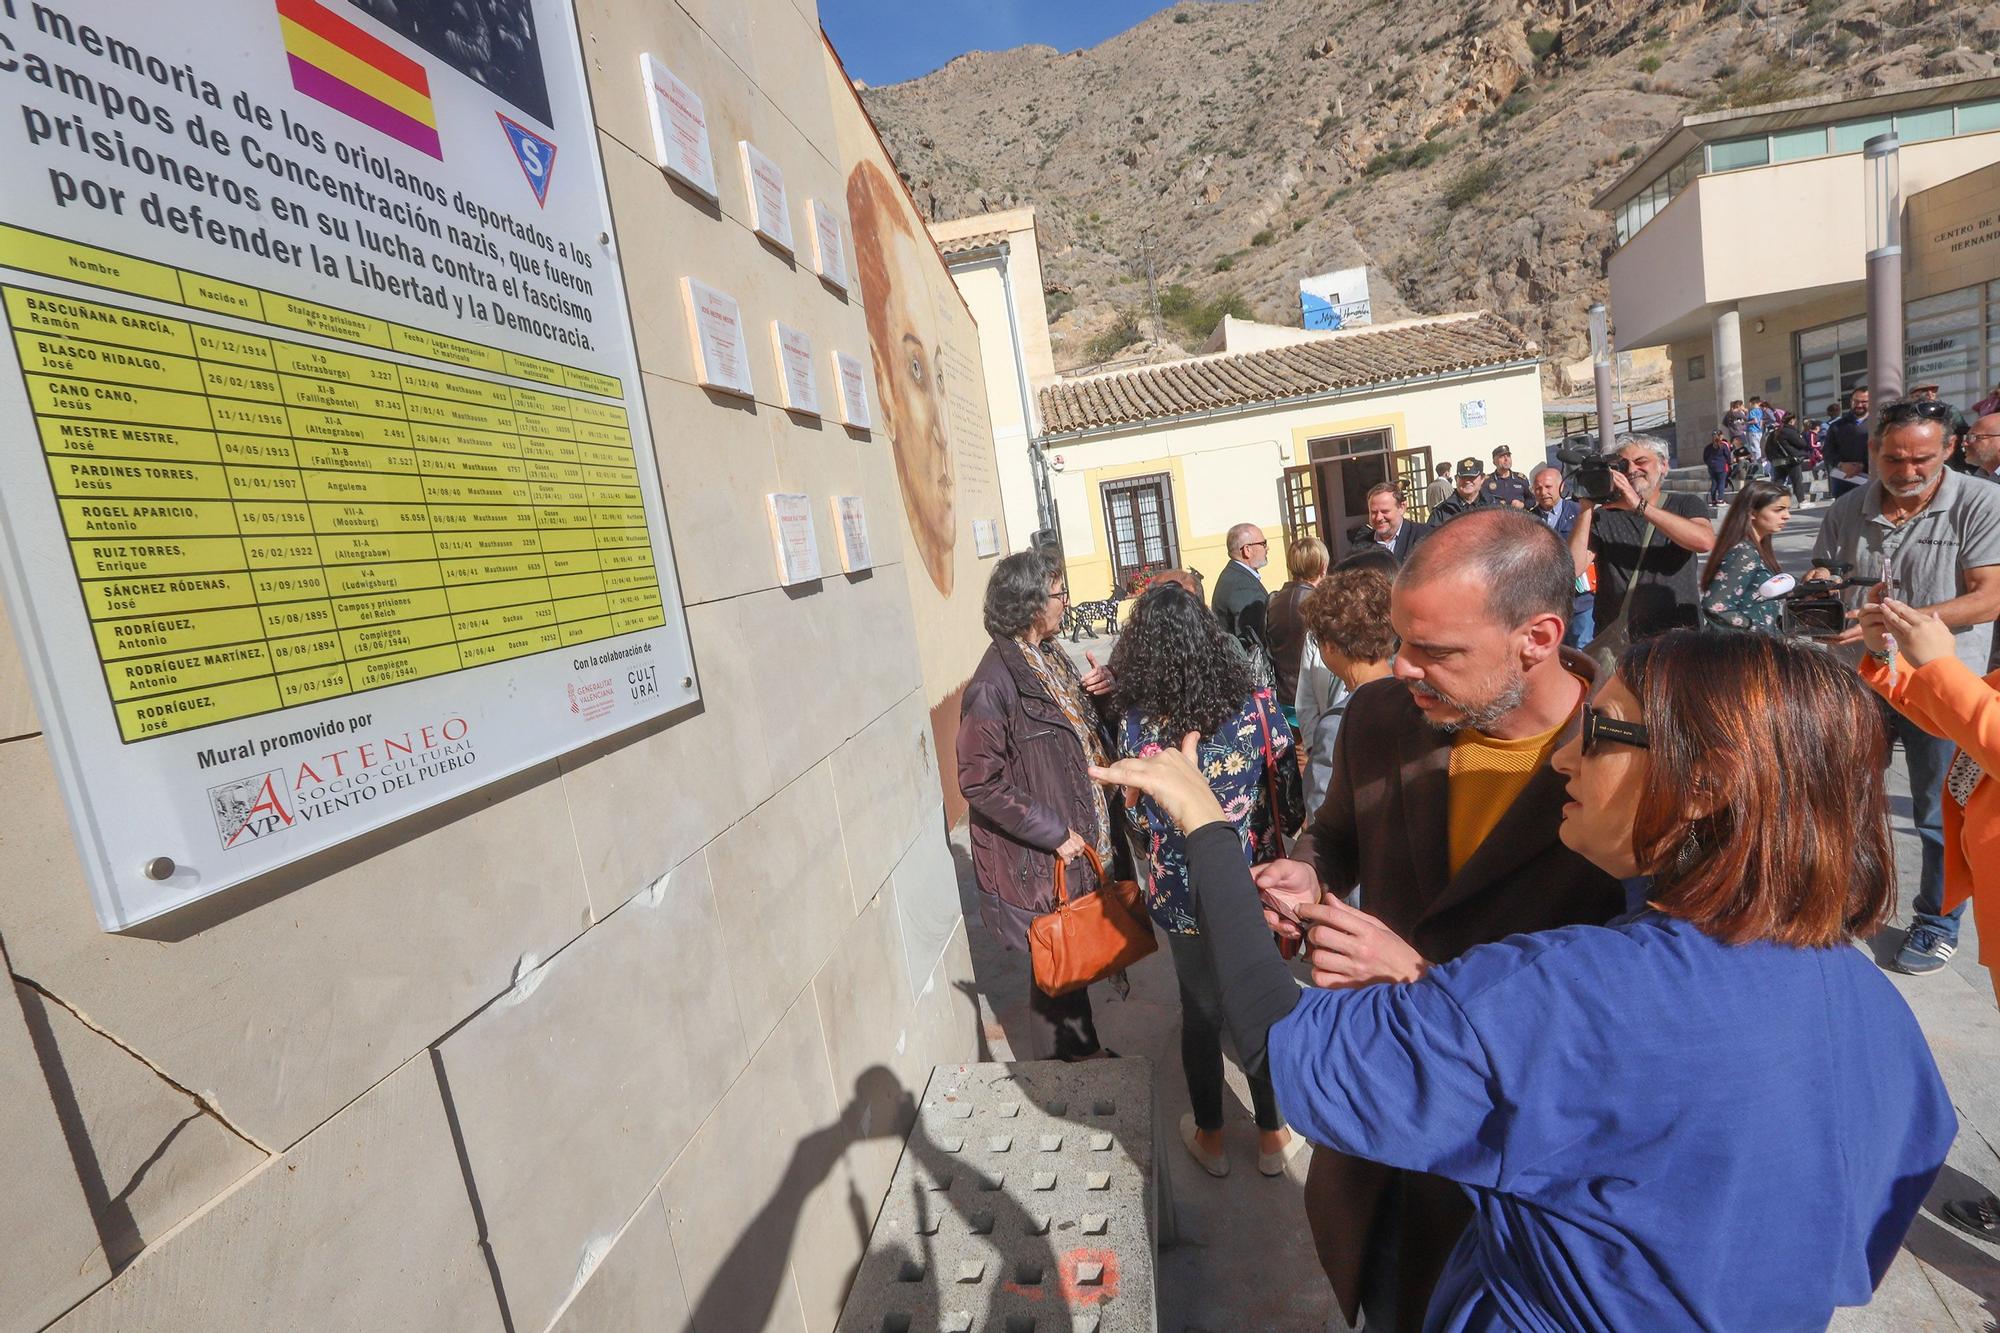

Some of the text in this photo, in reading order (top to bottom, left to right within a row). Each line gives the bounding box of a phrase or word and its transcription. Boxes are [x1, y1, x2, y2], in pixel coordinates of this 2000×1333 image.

[29, 0, 222, 110] memoria
[233, 91, 273, 131] de
[280, 109, 327, 154] los
[335, 141, 447, 207] oriolanos
[453, 191, 554, 252] deportados
[558, 242, 567, 258] a
[570, 242, 592, 268] los
[186, 114, 231, 156] de
[241, 135, 442, 239] Concentración
[447, 225, 504, 268] nazis,
[509, 251, 540, 276] que
[544, 259, 593, 296] fueron
[21, 105, 592, 323] prisioneros en su lucha contra el fascismo
[1934, 217, 1993, 243] CENTRO DE
[48, 168, 595, 351] por defender la Libertad y la Democracia.
[69, 256, 120, 277] Nombre
[199, 288, 248, 307] Nacido el
[27, 298, 174, 336] BASCUÑANA GARCÍA,
[30, 312, 79, 330] Ramón
[287, 304, 318, 319] Stalags
[329, 315, 366, 329] prisiones
[319, 321, 360, 338] Prisionero
[200, 337, 267, 357] 01/12/1914
[404, 332, 424, 343] Fecha
[431, 339, 449, 349] Lugar
[38, 342, 165, 372] BLASCO HIDALGO,
[43, 356, 73, 370] José
[292, 361, 350, 379] (Estrasburgo)
[49, 383, 136, 403] CANO CANO,
[297, 392, 359, 409] (Fallingbostel)
[54, 397, 92, 411] Jesús
[218, 410, 282, 425] 11/11/1916
[60, 425, 178, 445] MESTRE MESTRE,
[306, 425, 364, 439] (Altengrabow)
[65, 439, 94, 450] José
[225, 444, 290, 457] 04/05/1913
[311, 456, 372, 468] (Fallingbostel)
[71, 465, 198, 481] PARDINES TORRES,
[75, 479, 112, 490] Jesús
[233, 477, 296, 488] 01/01/1907
[328, 482, 367, 492] Angulema
[82, 507, 198, 518] ROGEL APARICIO,
[243, 513, 305, 523] 16/05/1916
[86, 520, 137, 530] Antonio
[333, 518, 379, 527] (Moosburg)
[93, 545, 185, 558] RUIZ TORRES,
[251, 547, 313, 558] 26/02/1922
[335, 549, 390, 560] (Altengrabow)
[97, 561, 147, 572] Enrique
[104, 579, 230, 597] SÁNCHEZ RÓDENAS,
[342, 578, 397, 591] (Ludwigsburg)
[108, 601, 136, 610] José
[338, 603, 370, 612] Campos
[377, 598, 411, 609] prisiones
[269, 610, 328, 625] 15/08/1895
[360, 609, 396, 620] del Reich
[114, 619, 195, 637] RODRÍGUEZ,
[359, 629, 401, 641] Compiègne
[119, 635, 167, 649] Antonio
[276, 640, 335, 657] 08/08/1894
[354, 637, 410, 654] (18/06/1944)
[125, 648, 264, 677] RODRÍGUEZ MARTÍNEZ,
[573, 642, 651, 671] Con la colaboración de
[367, 660, 408, 673] Compiègne
[130, 675, 177, 690] Antonio
[362, 667, 417, 686] (18/06/1944)
[286, 676, 343, 695] 19/03/1919
[137, 697, 215, 719] RODRÍGUEZ,
[141, 720, 168, 733] José
[197, 714, 372, 769] Mural promovido por
[296, 718, 467, 790] ATENEO
[297, 739, 471, 805] SOCIO-CULTURAL
[300, 752, 475, 821] VIENTO DEL PUEBLO
